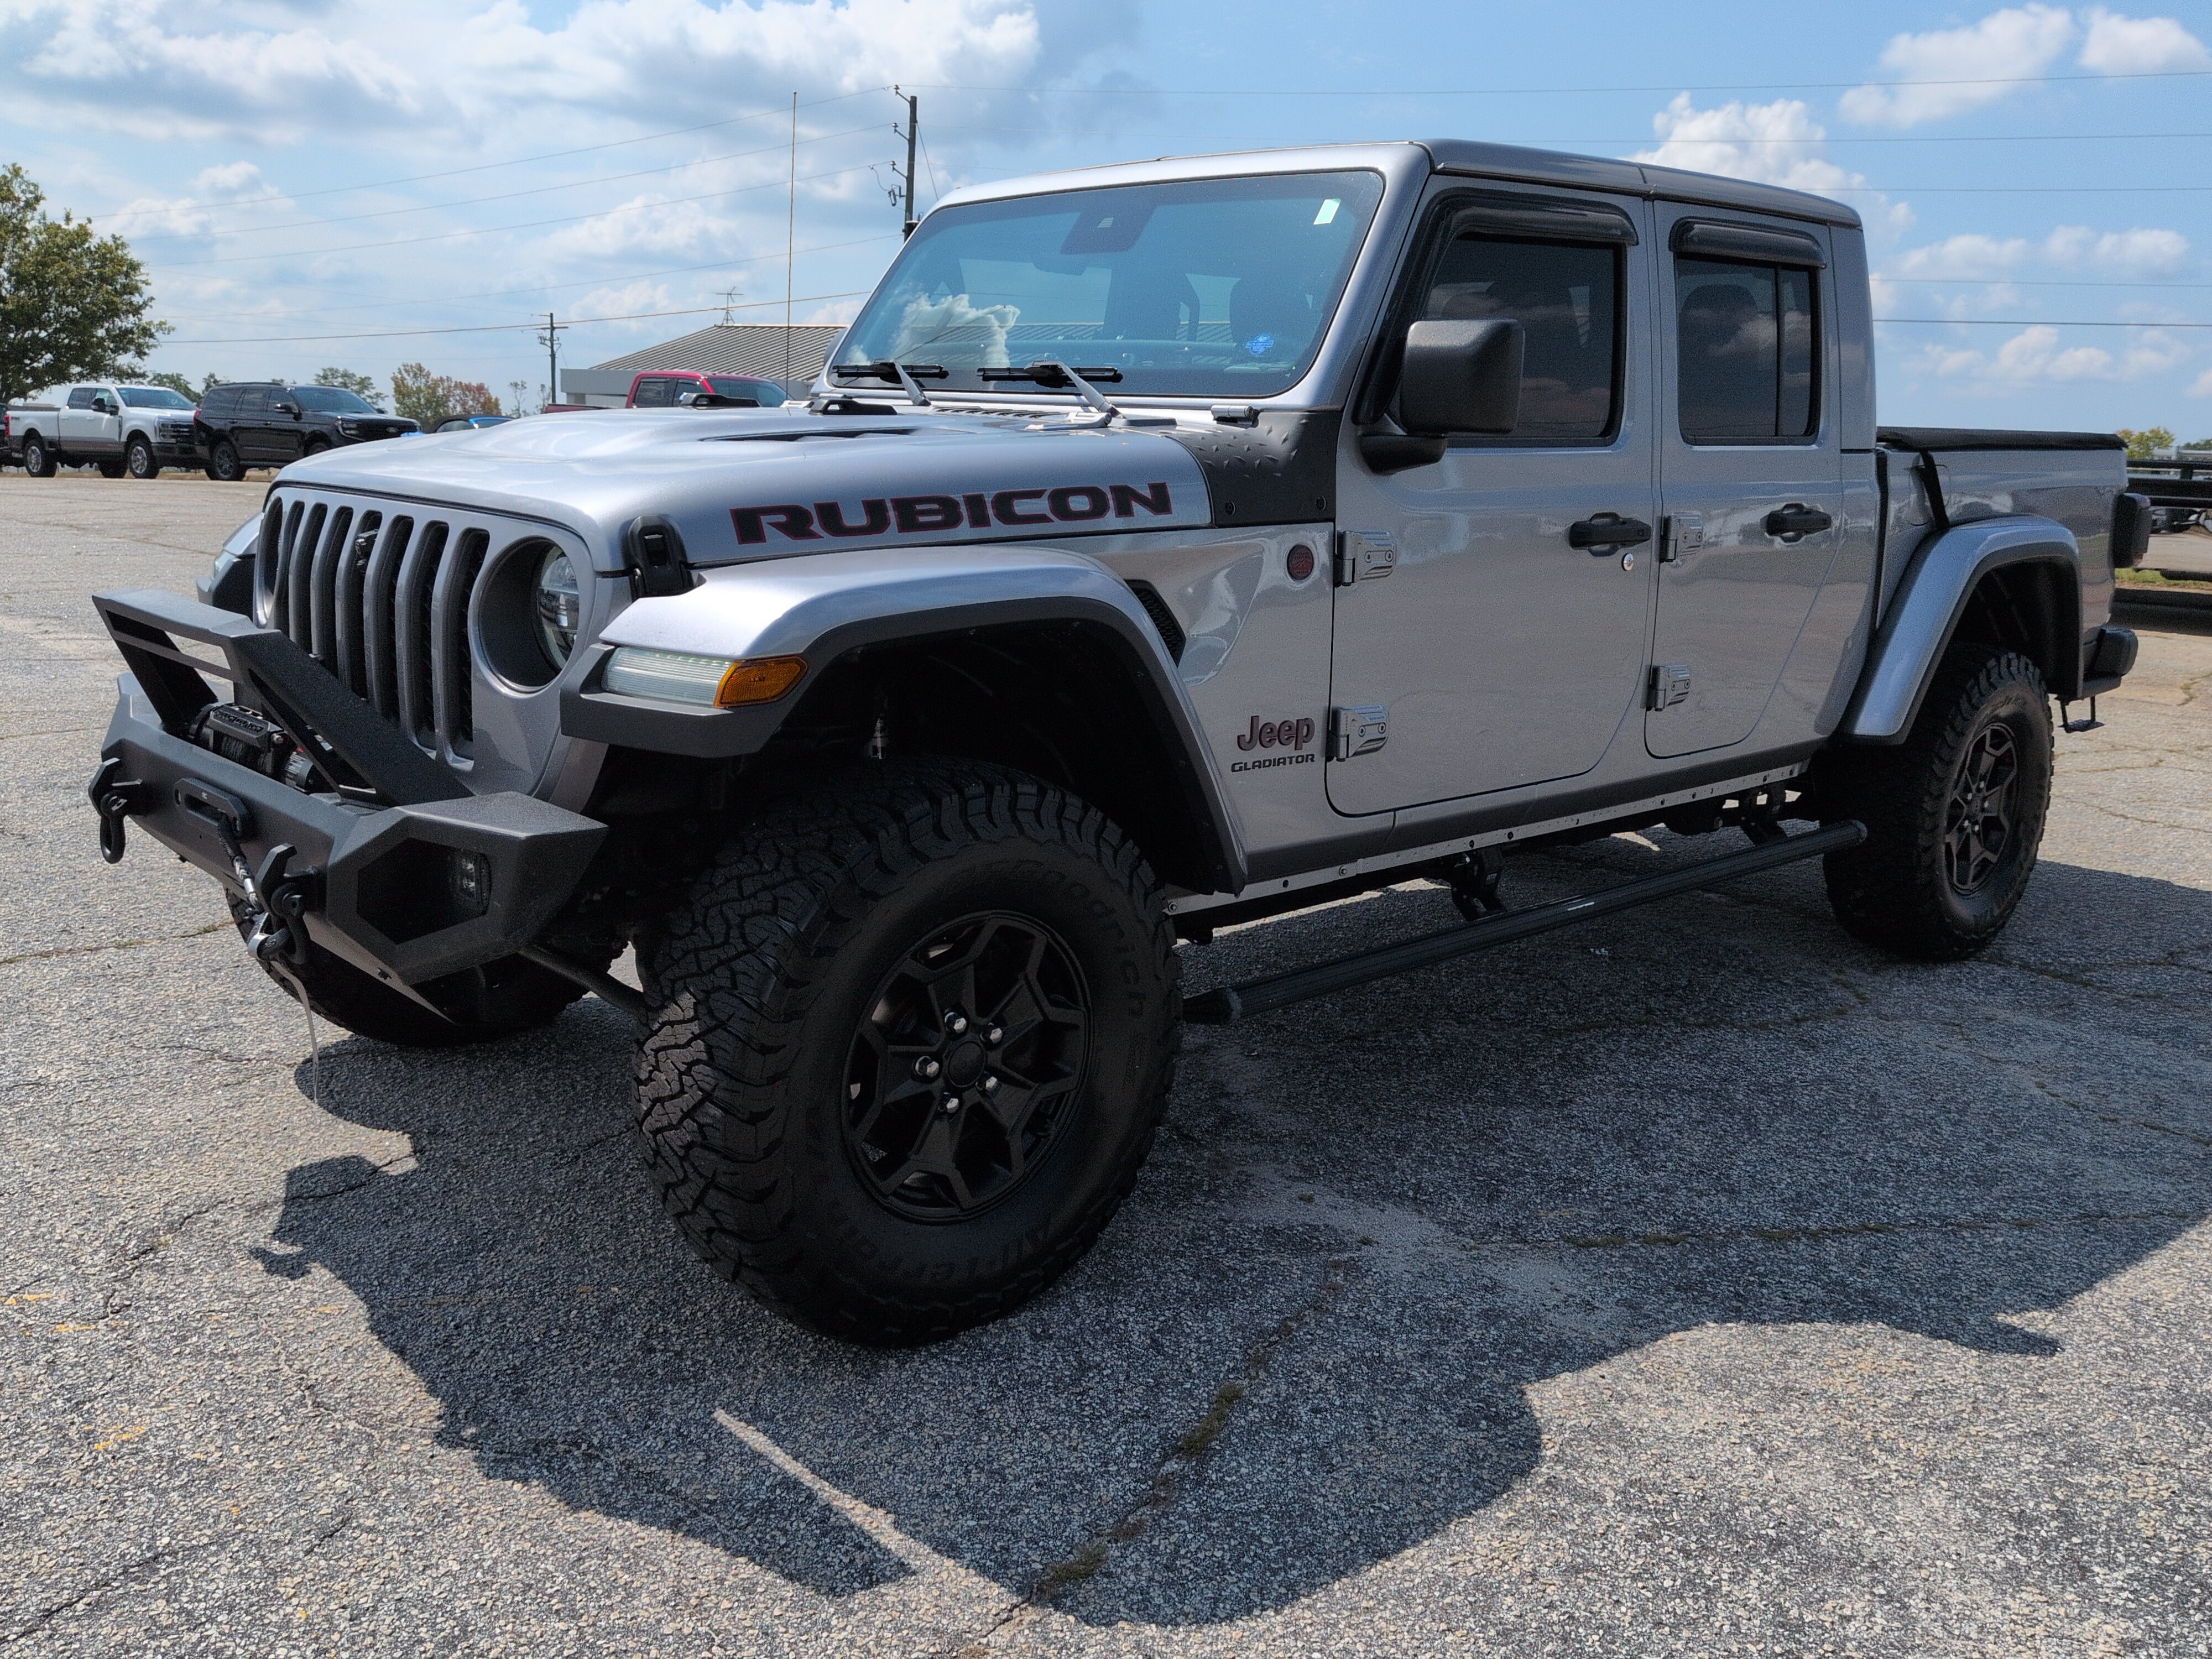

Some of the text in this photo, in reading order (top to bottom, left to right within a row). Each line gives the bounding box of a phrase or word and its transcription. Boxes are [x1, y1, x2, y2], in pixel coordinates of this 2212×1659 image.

[729, 482, 1173, 545] RUBICON
[1237, 714, 1316, 751] Jeep
[1230, 753, 1316, 773] GLADIATOR
